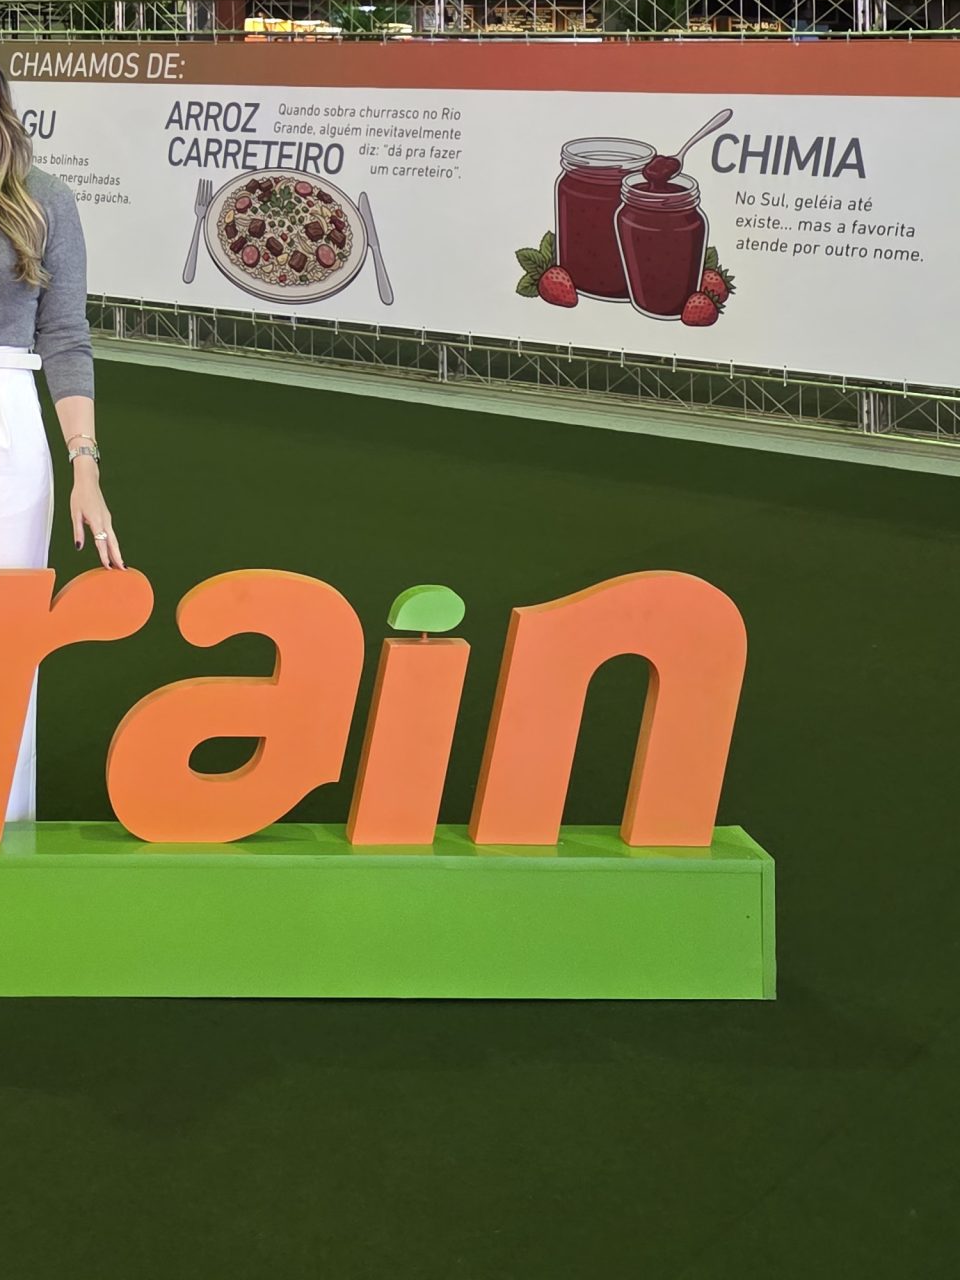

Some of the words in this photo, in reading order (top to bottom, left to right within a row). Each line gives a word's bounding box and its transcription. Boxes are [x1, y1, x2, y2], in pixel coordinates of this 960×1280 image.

[9, 51, 139, 79] CHAMAMOS
[147, 53, 186, 80] DE:
[164, 100, 261, 133] ARROZ
[278, 103, 321, 118] Quando
[323, 106, 356, 118] sobra
[359, 106, 420, 120] churrasco
[422, 110, 438, 120] no
[441, 107, 462, 121] Rio
[273, 121, 316, 136] Grande,
[319, 123, 362, 139] alguém
[365, 125, 462, 141] inevitavelmente
[50, 154, 89, 167] bolinhas
[167, 136, 345, 175] CARRETEIRO
[358, 144, 380, 156] diz:
[405, 148, 426, 160] pra
[429, 146, 462, 160] fazer
[710, 133, 867, 180] CHIMIA
[59, 173, 121, 186] mergulhadas
[370, 165, 389, 176] um
[94, 191, 132, 205] gaúcha.
[735, 191, 756, 206] No
[760, 192, 790, 209] Sul,
[794, 194, 842, 212] geléia
[847, 196, 873, 212] até
[735, 214, 792, 231] existe...
[797, 220, 832, 233] mas
[836, 222, 846, 234] a
[851, 220, 916, 238] favorita
[736, 237, 788, 253] atende
[792, 242, 821, 257] por
[824, 244, 868, 258] outro
[873, 248, 924, 263] nome.
